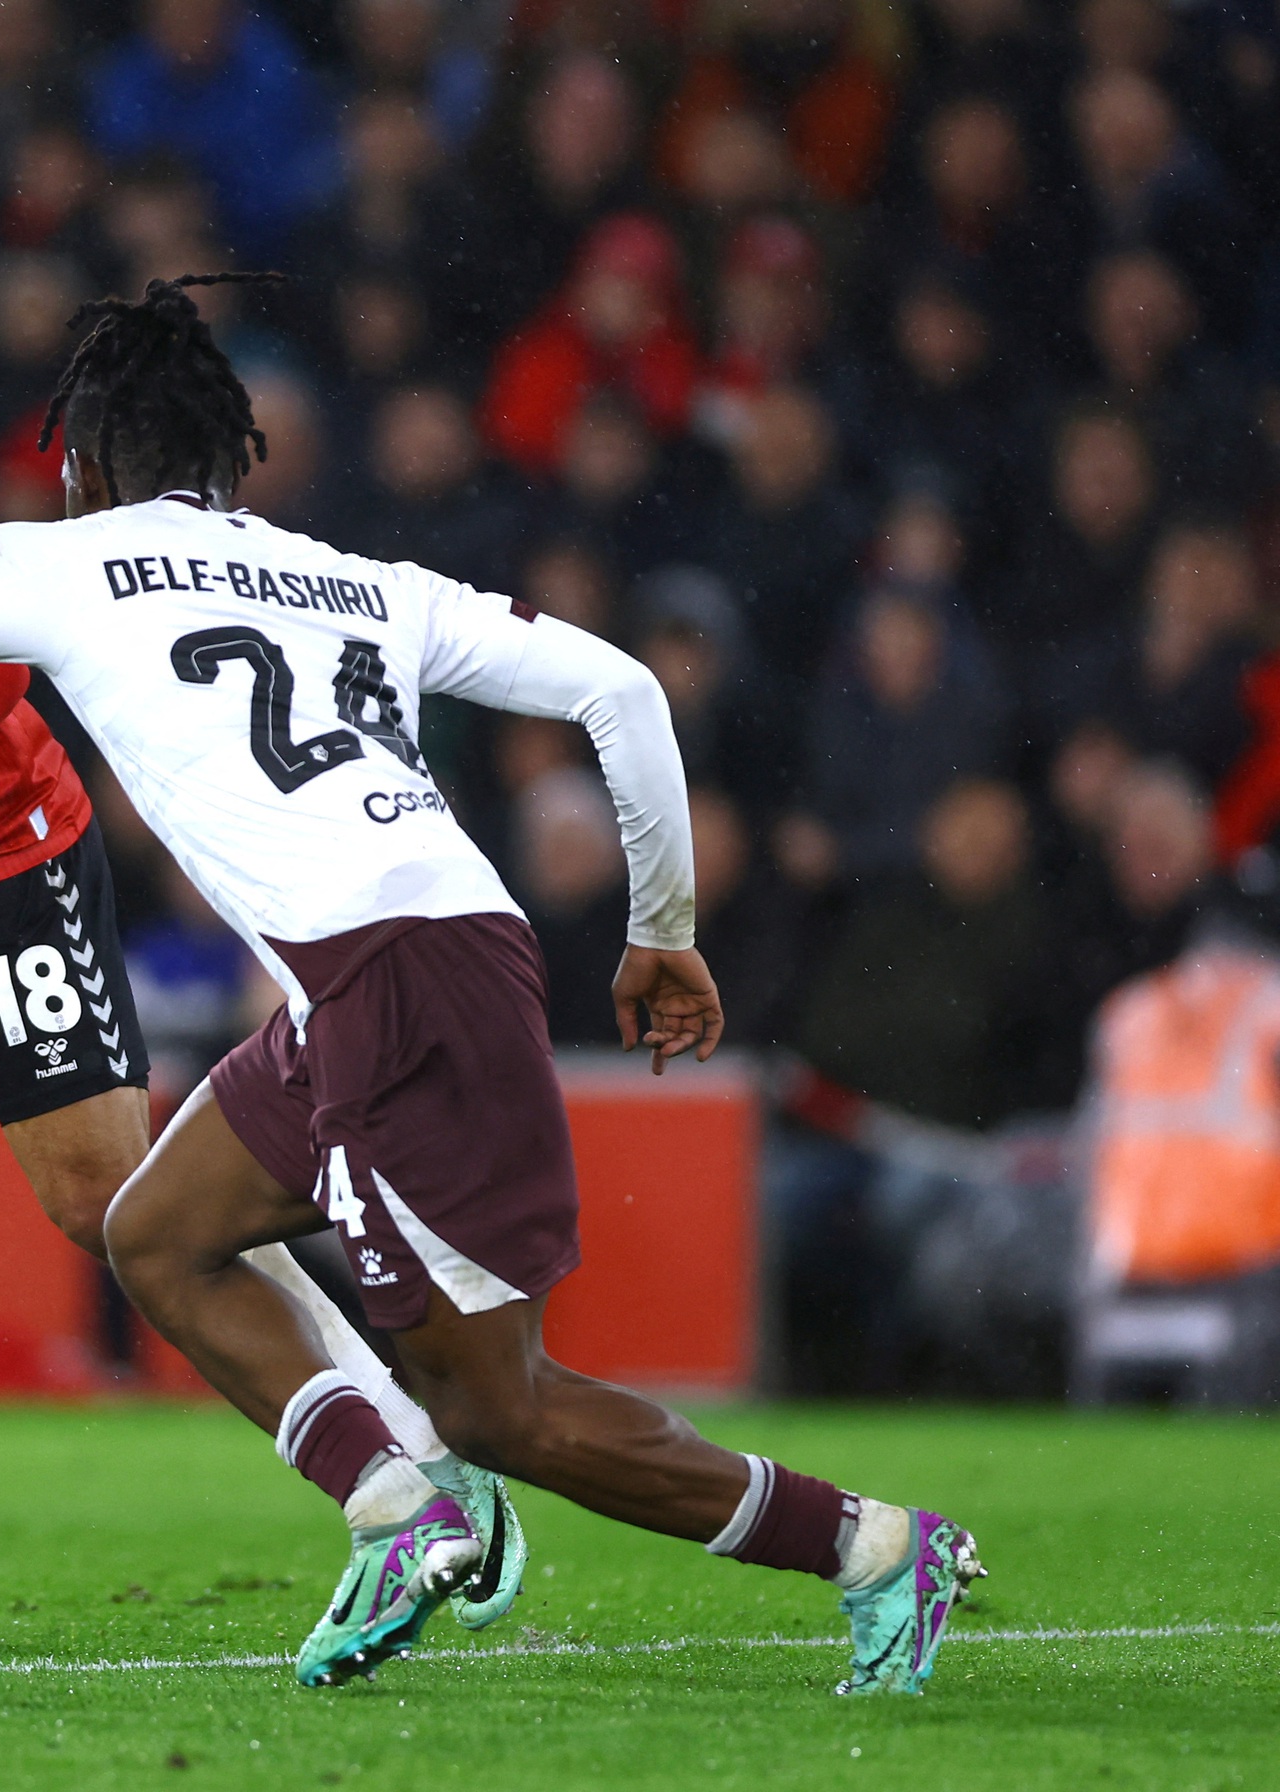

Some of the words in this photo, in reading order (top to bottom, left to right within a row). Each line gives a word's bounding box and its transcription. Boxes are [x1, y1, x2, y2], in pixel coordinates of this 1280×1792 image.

[103, 556, 389, 623] DELE-BASHIRU
[170, 625, 428, 794] 24
[35, 1059, 78, 1079] hummel
[312, 1144, 367, 1239] 4
